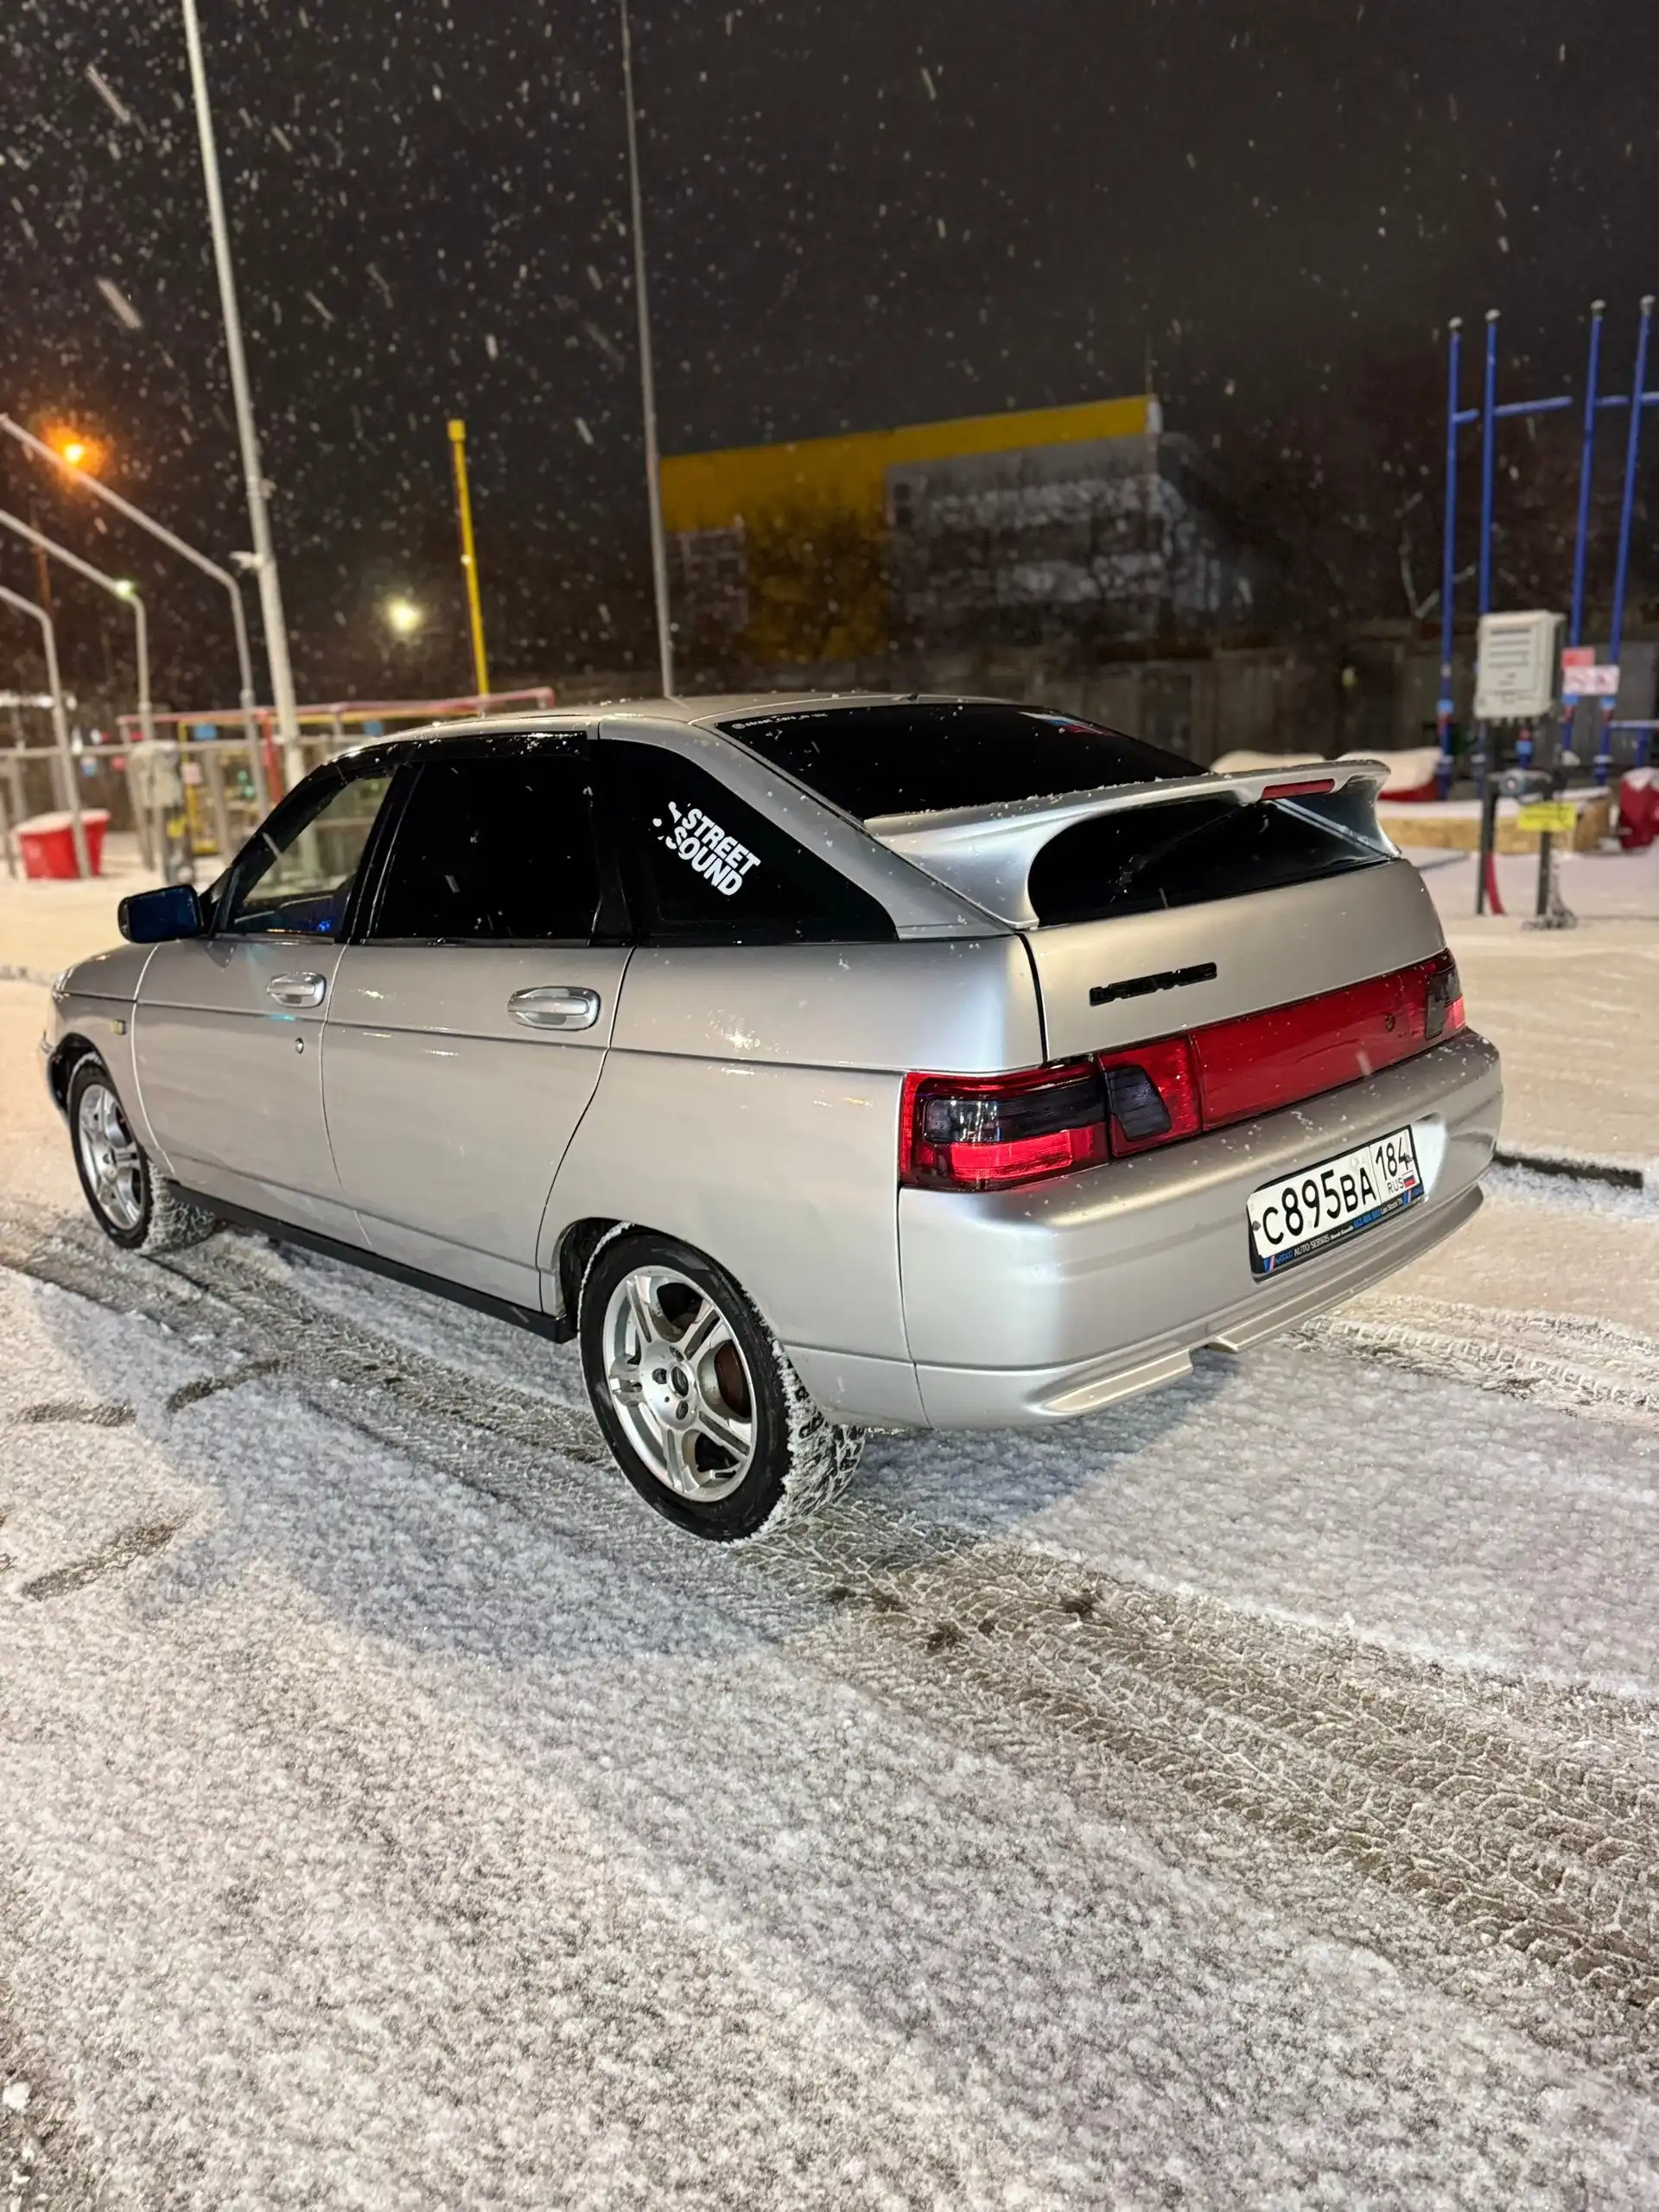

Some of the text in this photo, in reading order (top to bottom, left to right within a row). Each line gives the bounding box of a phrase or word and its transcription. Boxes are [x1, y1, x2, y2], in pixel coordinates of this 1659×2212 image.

[665, 826, 743, 896] SOUND
[682, 808, 761, 875] STREET
[1376, 1136, 1409, 1181] 184
[1387, 1178, 1404, 1195] RUS
[1294, 1243, 1311, 1256] AUTO
